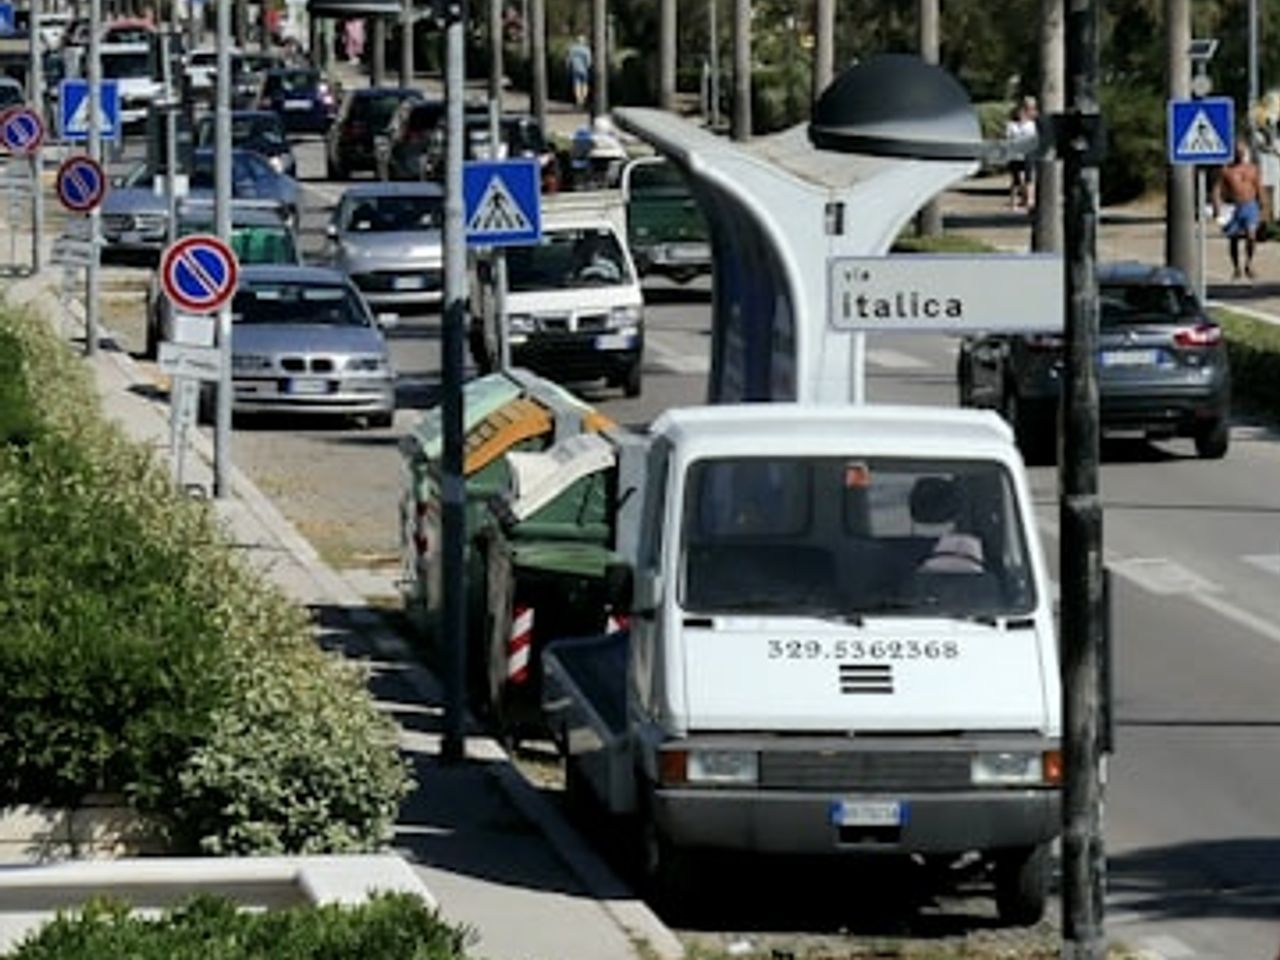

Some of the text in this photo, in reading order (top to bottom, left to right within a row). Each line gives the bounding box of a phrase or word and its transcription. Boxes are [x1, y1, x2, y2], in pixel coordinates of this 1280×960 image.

[844, 269, 870, 281] via
[842, 292, 962, 318] italica
[767, 639, 959, 659] 329.5362368
